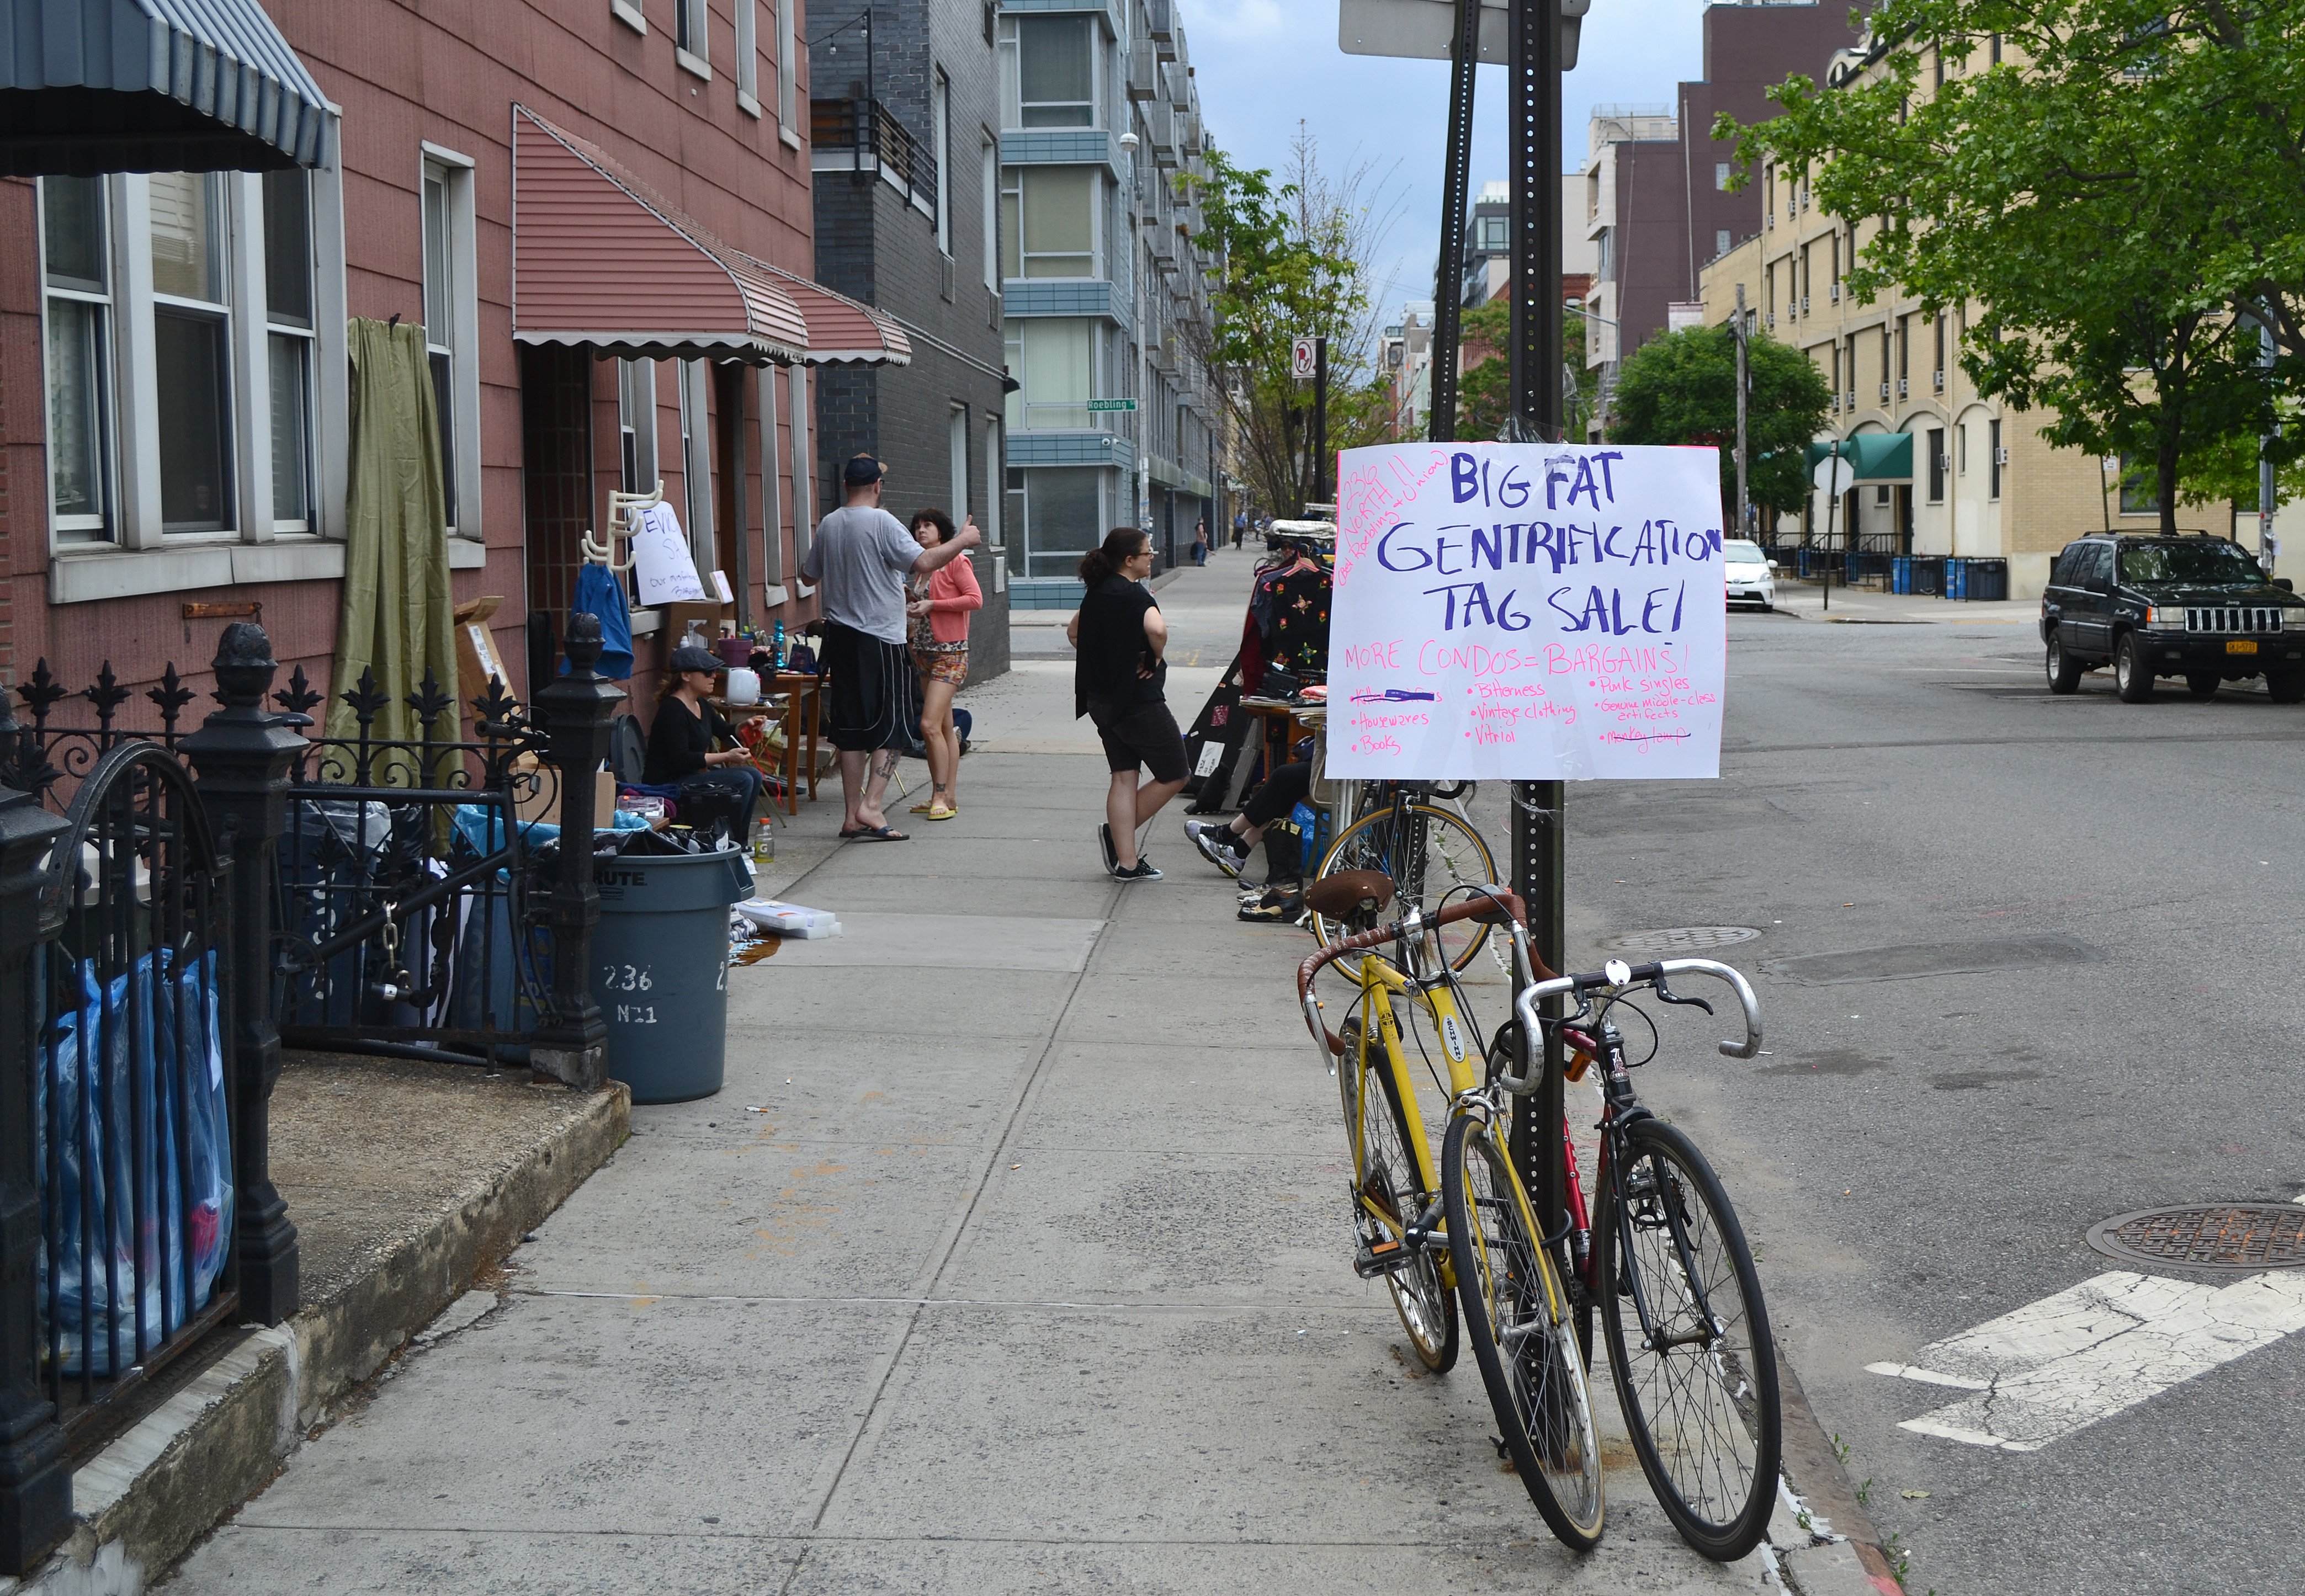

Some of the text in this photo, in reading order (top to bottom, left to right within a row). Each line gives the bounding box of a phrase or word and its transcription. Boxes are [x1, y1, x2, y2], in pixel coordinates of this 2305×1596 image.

[1088, 400, 1127, 409] Roebling
[1344, 465, 1377, 510] 236
[1451, 451, 1623, 512] BIG FAT
[1345, 478, 1393, 547] NORTH
[1349, 511, 1400, 559] Roebling
[1378, 520, 1722, 574] GENTRIFICATION
[1423, 582, 1531, 631] TAG
[1345, 640, 1404, 670] MORE
[1474, 678, 1545, 698] Bitterness
[1597, 674, 1690, 696] Punk singles
[1478, 700, 1576, 726] Vintage clothing
[1601, 698, 1639, 711] Genuine
[1359, 735, 1401, 756] Books
[1475, 723, 1516, 745] Vitriol
[603, 964, 652, 991] 236
[1446, 1020, 1461, 1056] SCHWINN
